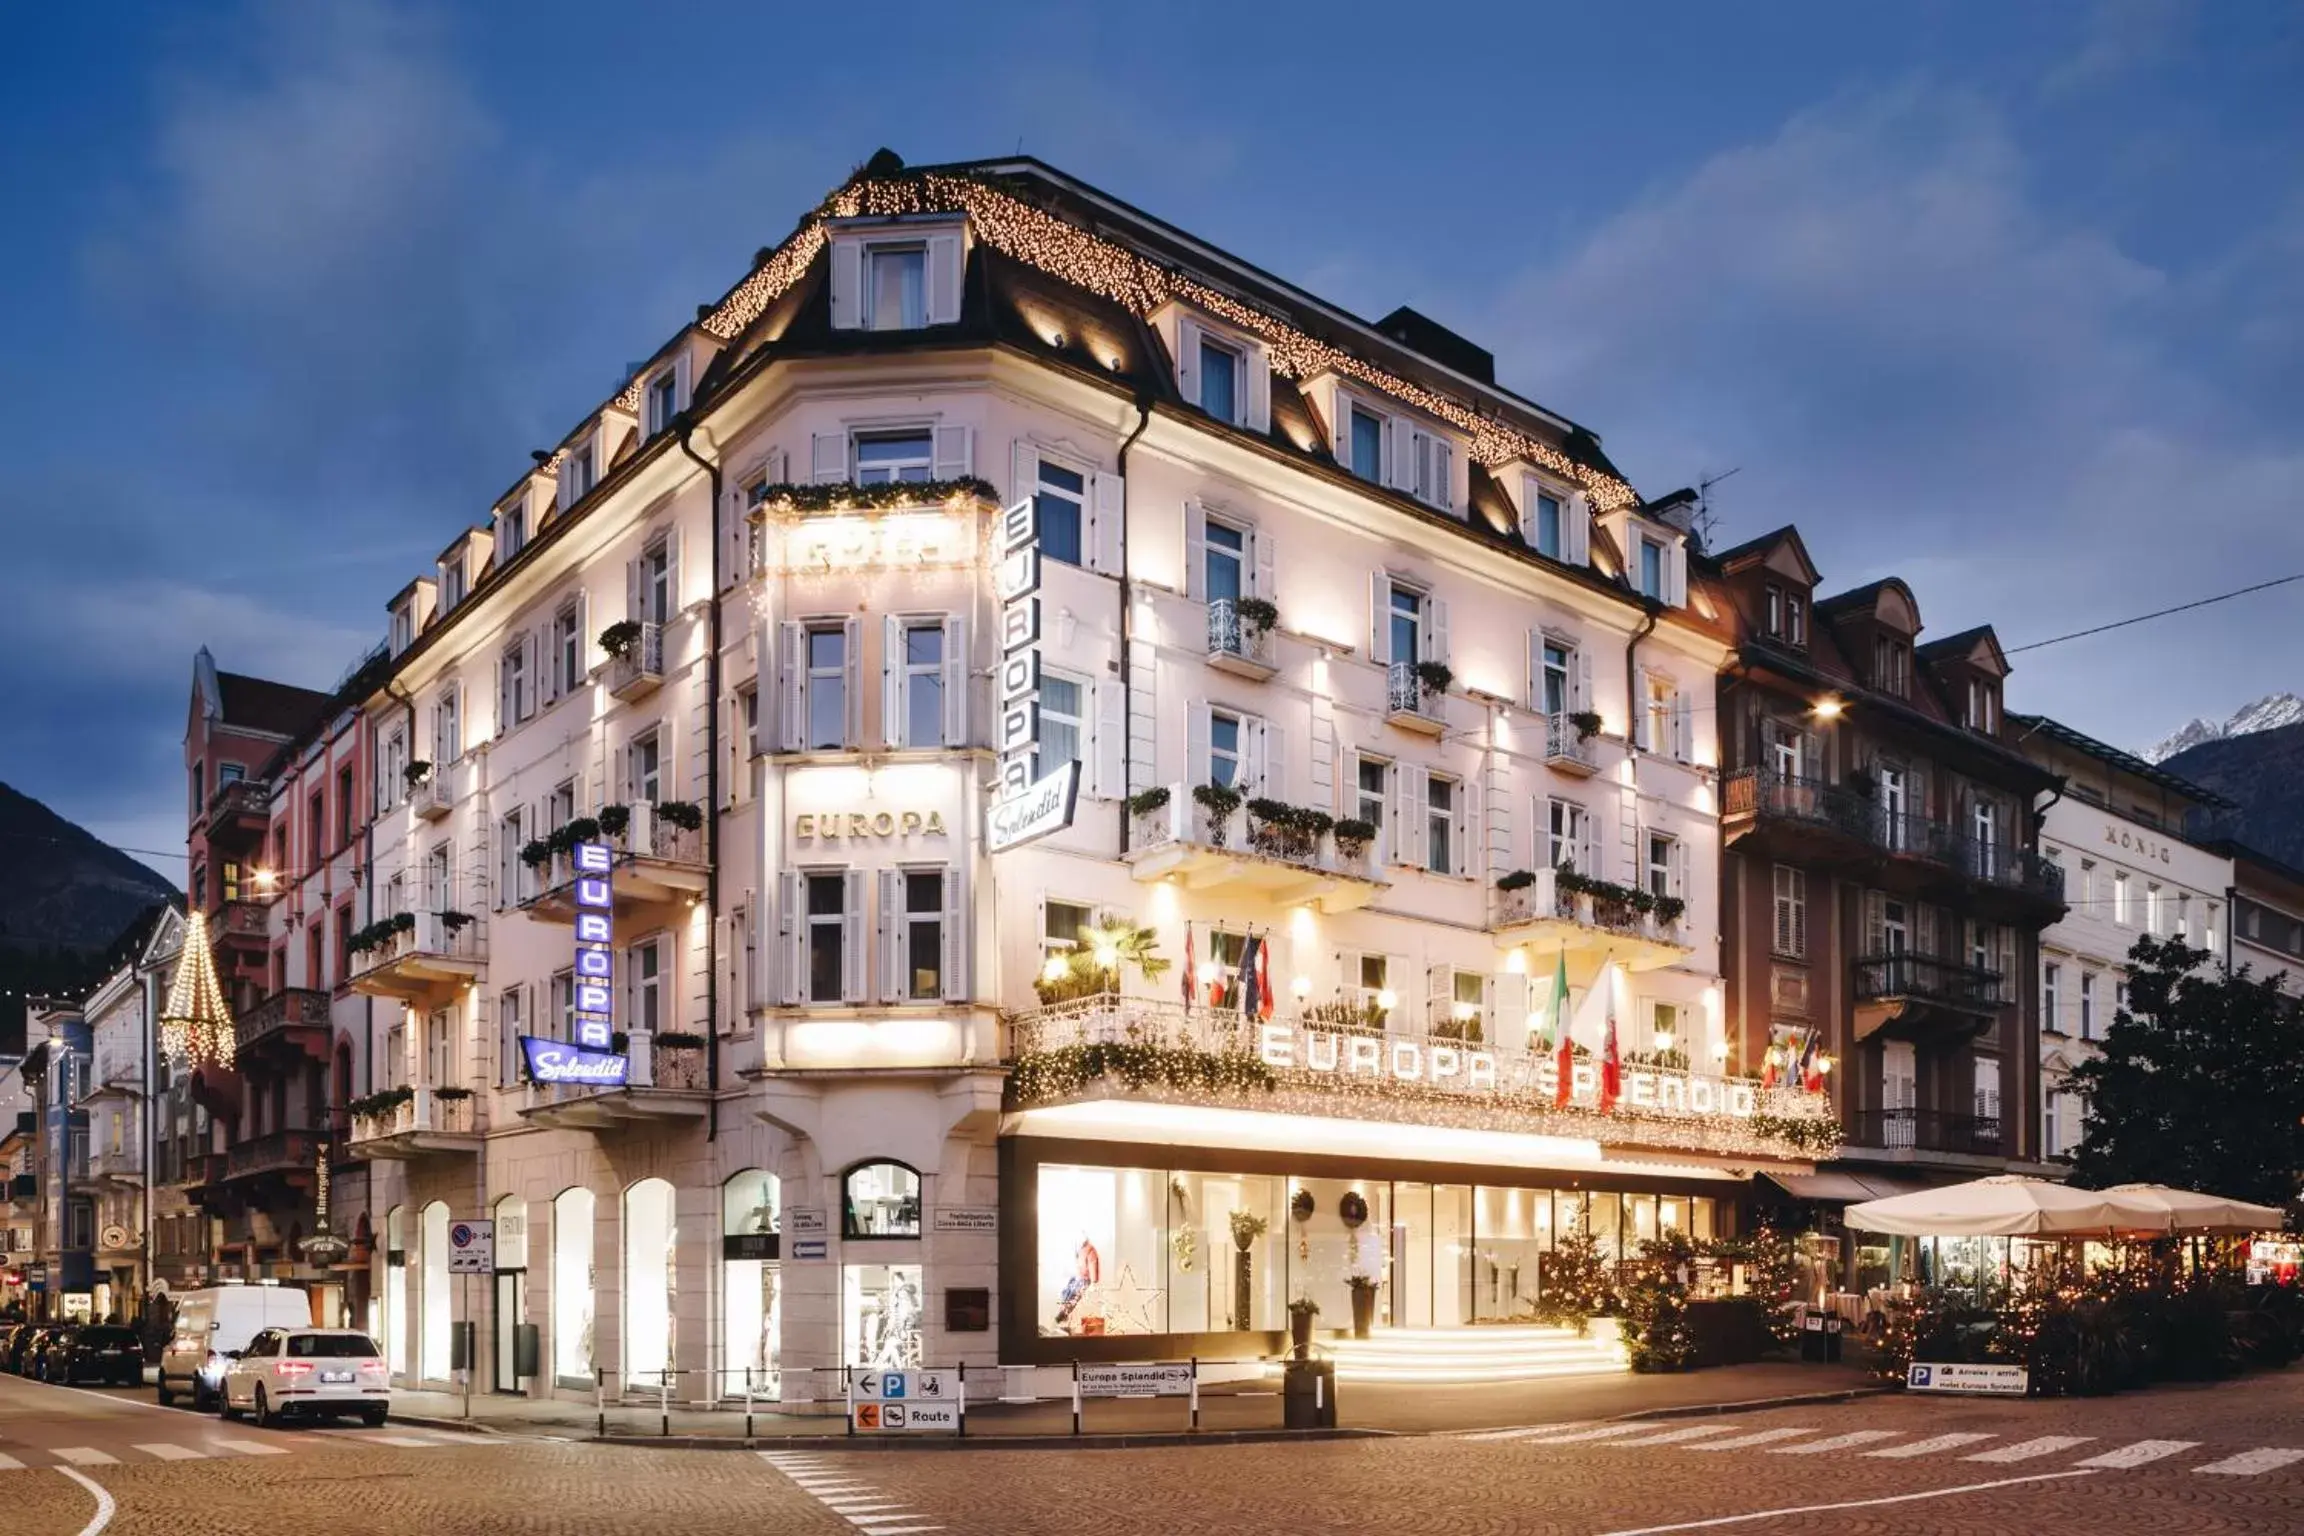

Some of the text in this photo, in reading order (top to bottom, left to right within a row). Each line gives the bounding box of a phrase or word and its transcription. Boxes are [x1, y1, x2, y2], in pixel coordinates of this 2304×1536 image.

[1005, 504, 1029, 798] EUROPA
[796, 811, 948, 840] EUROPA
[994, 780, 1062, 845] Splendid
[581, 845, 609, 1047] EUROPA
[535, 1051, 627, 1080] Splendid
[1261, 1025, 1754, 1117] EUROPA SPENDID
[886, 1375, 901, 1396] P
[1082, 1371, 1166, 1382] Europa Splendid
[911, 1410, 950, 1422] Route
